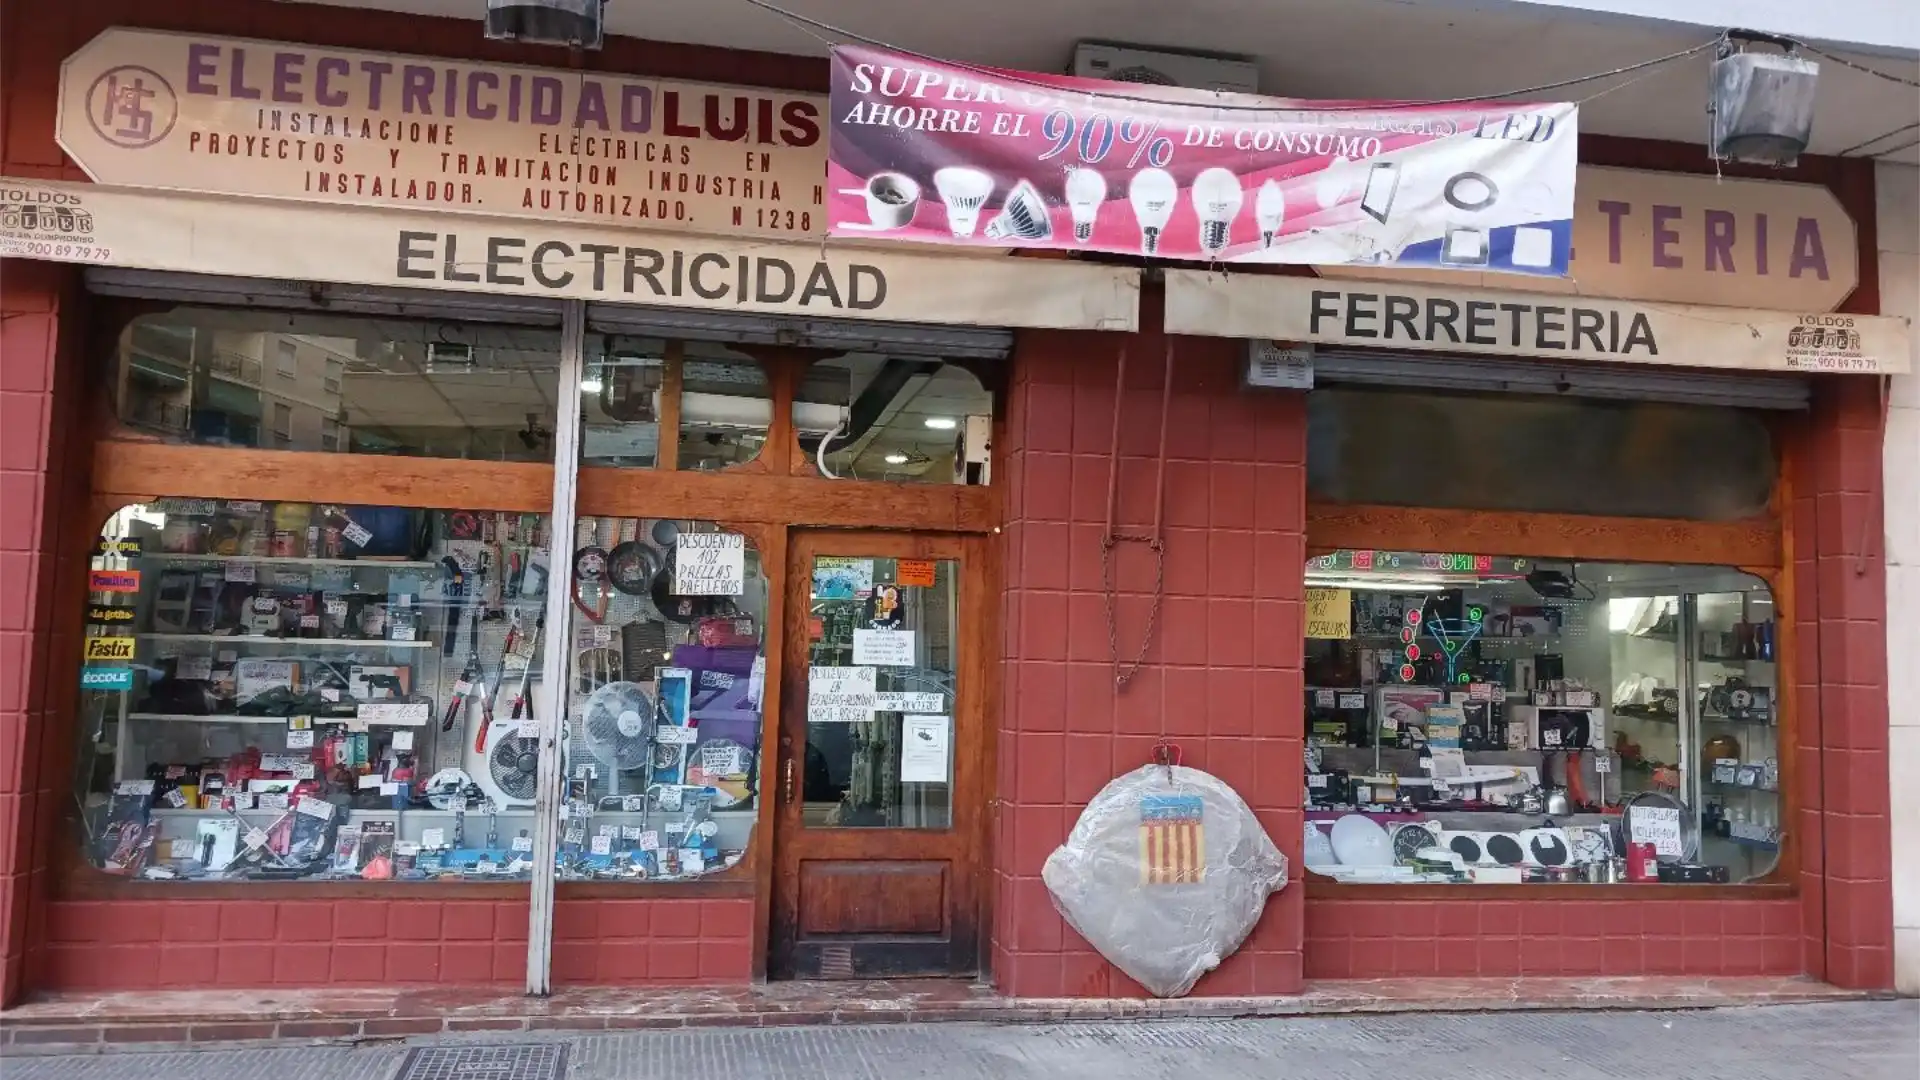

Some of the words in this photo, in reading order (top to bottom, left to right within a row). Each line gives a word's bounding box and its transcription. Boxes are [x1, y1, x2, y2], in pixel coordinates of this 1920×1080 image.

[186, 43, 652, 134] ELECTRICIDAD
[662, 90, 821, 148] LUIS
[843, 101, 983, 134] AHORRE
[989, 112, 1031, 138] EL
[1038, 108, 1175, 169] 90%
[1182, 124, 1225, 149] DE
[1233, 127, 1382, 160] CONSUMO
[1472, 111, 1555, 144] LED
[190, 131, 345, 164] PROYECTOS
[389, 149, 400, 169] Y
[440, 152, 617, 187] TRAMITACION
[648, 169, 781, 202] INDUSTRIA
[539, 132, 691, 166] ELECTRICAS
[745, 151, 771, 173] EN
[0, 189, 82, 205] TOLDOS
[304, 170, 483, 205] INSTALADOR.
[521, 187, 694, 223] AUTORIZADO.
[756, 208, 811, 232] 1238
[2, 206, 94, 234] OLDER
[1570, 199, 1830, 282] TERIA
[27, 242, 52, 256] 900
[55, 245, 72, 257] 89
[75, 246, 92, 259] 79
[94, 248, 111, 260] 79
[397, 230, 888, 311] ELECTRICIDAD
[1308, 290, 1660, 357] FERRETERIA
[1798, 315, 1855, 328] TOLDOS
[679, 534, 742, 549] DESCUENTO
[87, 640, 131, 657] Fastix
